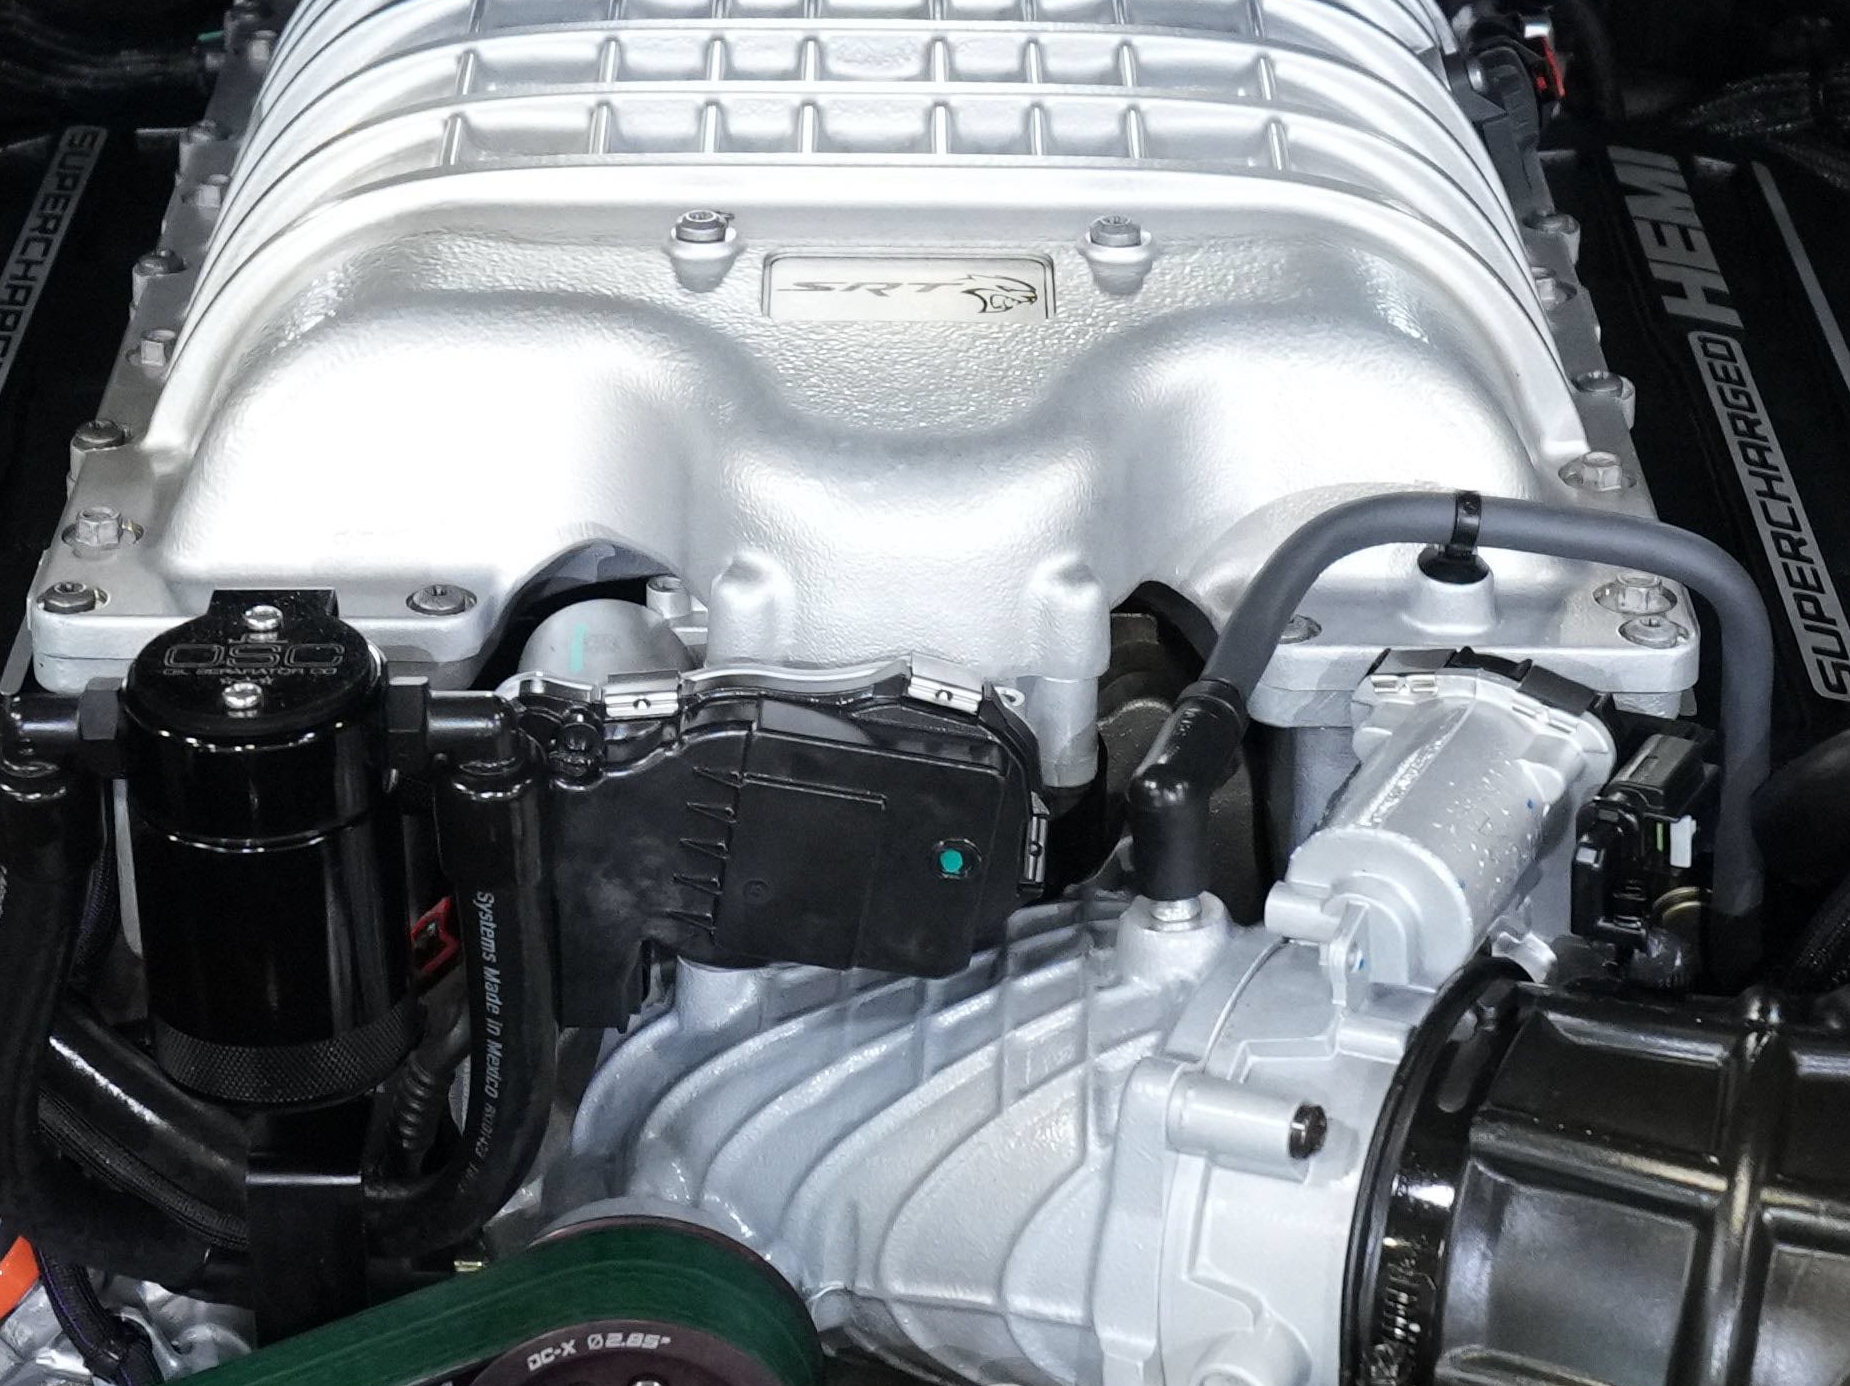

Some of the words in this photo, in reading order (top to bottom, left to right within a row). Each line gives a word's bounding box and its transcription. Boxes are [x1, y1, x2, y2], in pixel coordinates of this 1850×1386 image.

[1607, 146, 1743, 329] HEMI
[776, 279, 963, 298] SRT
[474, 890, 498, 962] Systems
[483, 965, 504, 1016] Made
[485, 1017, 505, 1037] in
[483, 1039, 504, 1101] Mexico
